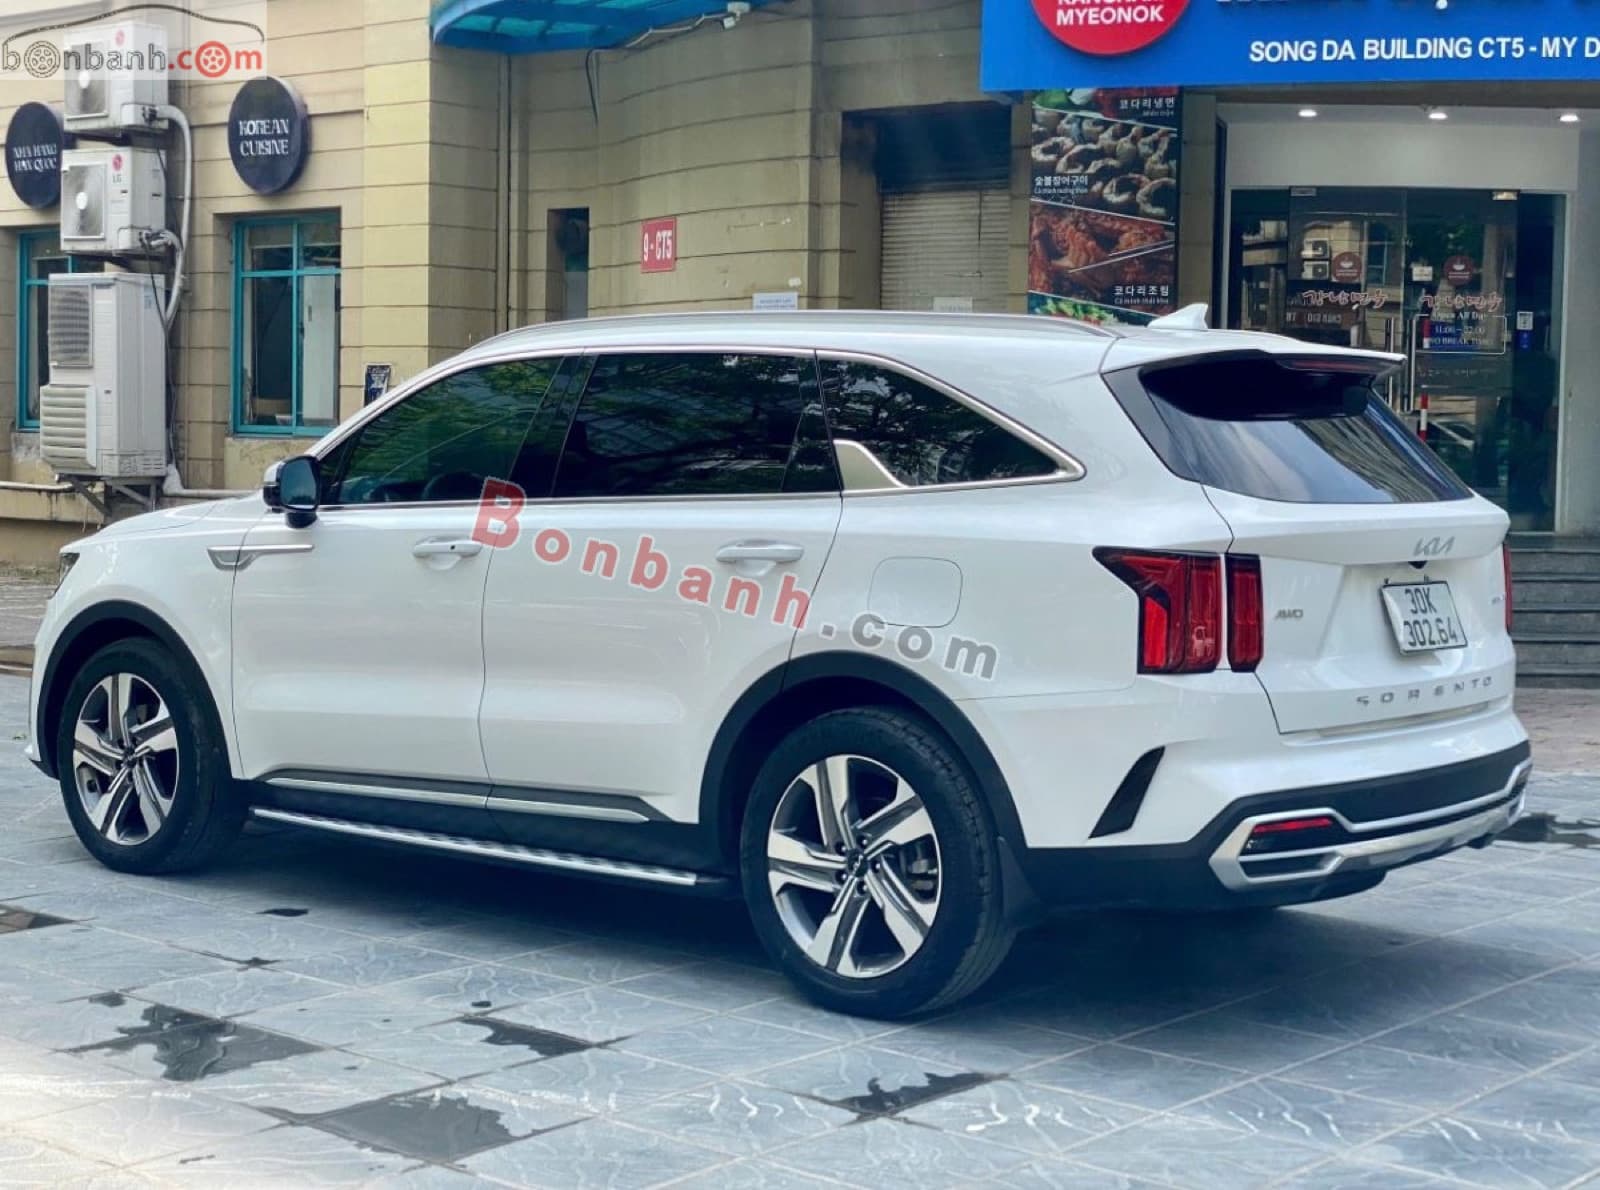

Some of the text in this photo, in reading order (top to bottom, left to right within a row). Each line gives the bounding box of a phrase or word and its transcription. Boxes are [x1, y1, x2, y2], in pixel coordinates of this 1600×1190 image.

[1056, 5, 1164, 26] MYEONOK
[1250, 40, 1317, 62] SONG
[1322, 40, 1356, 61] DA
[1364, 38, 1472, 60] BUILDING
[1478, 37, 1524, 58] CT5
[1542, 37, 1577, 58] MY
[239, 118, 289, 136] KOREAN
[240, 139, 289, 156] CUISINE
[643, 232, 649, 262] 9
[655, 229, 673, 260] CT5
[1404, 587, 1437, 615] 30K
[1403, 617, 1458, 647] 302.64
[1356, 675, 1493, 706] SORENTO
